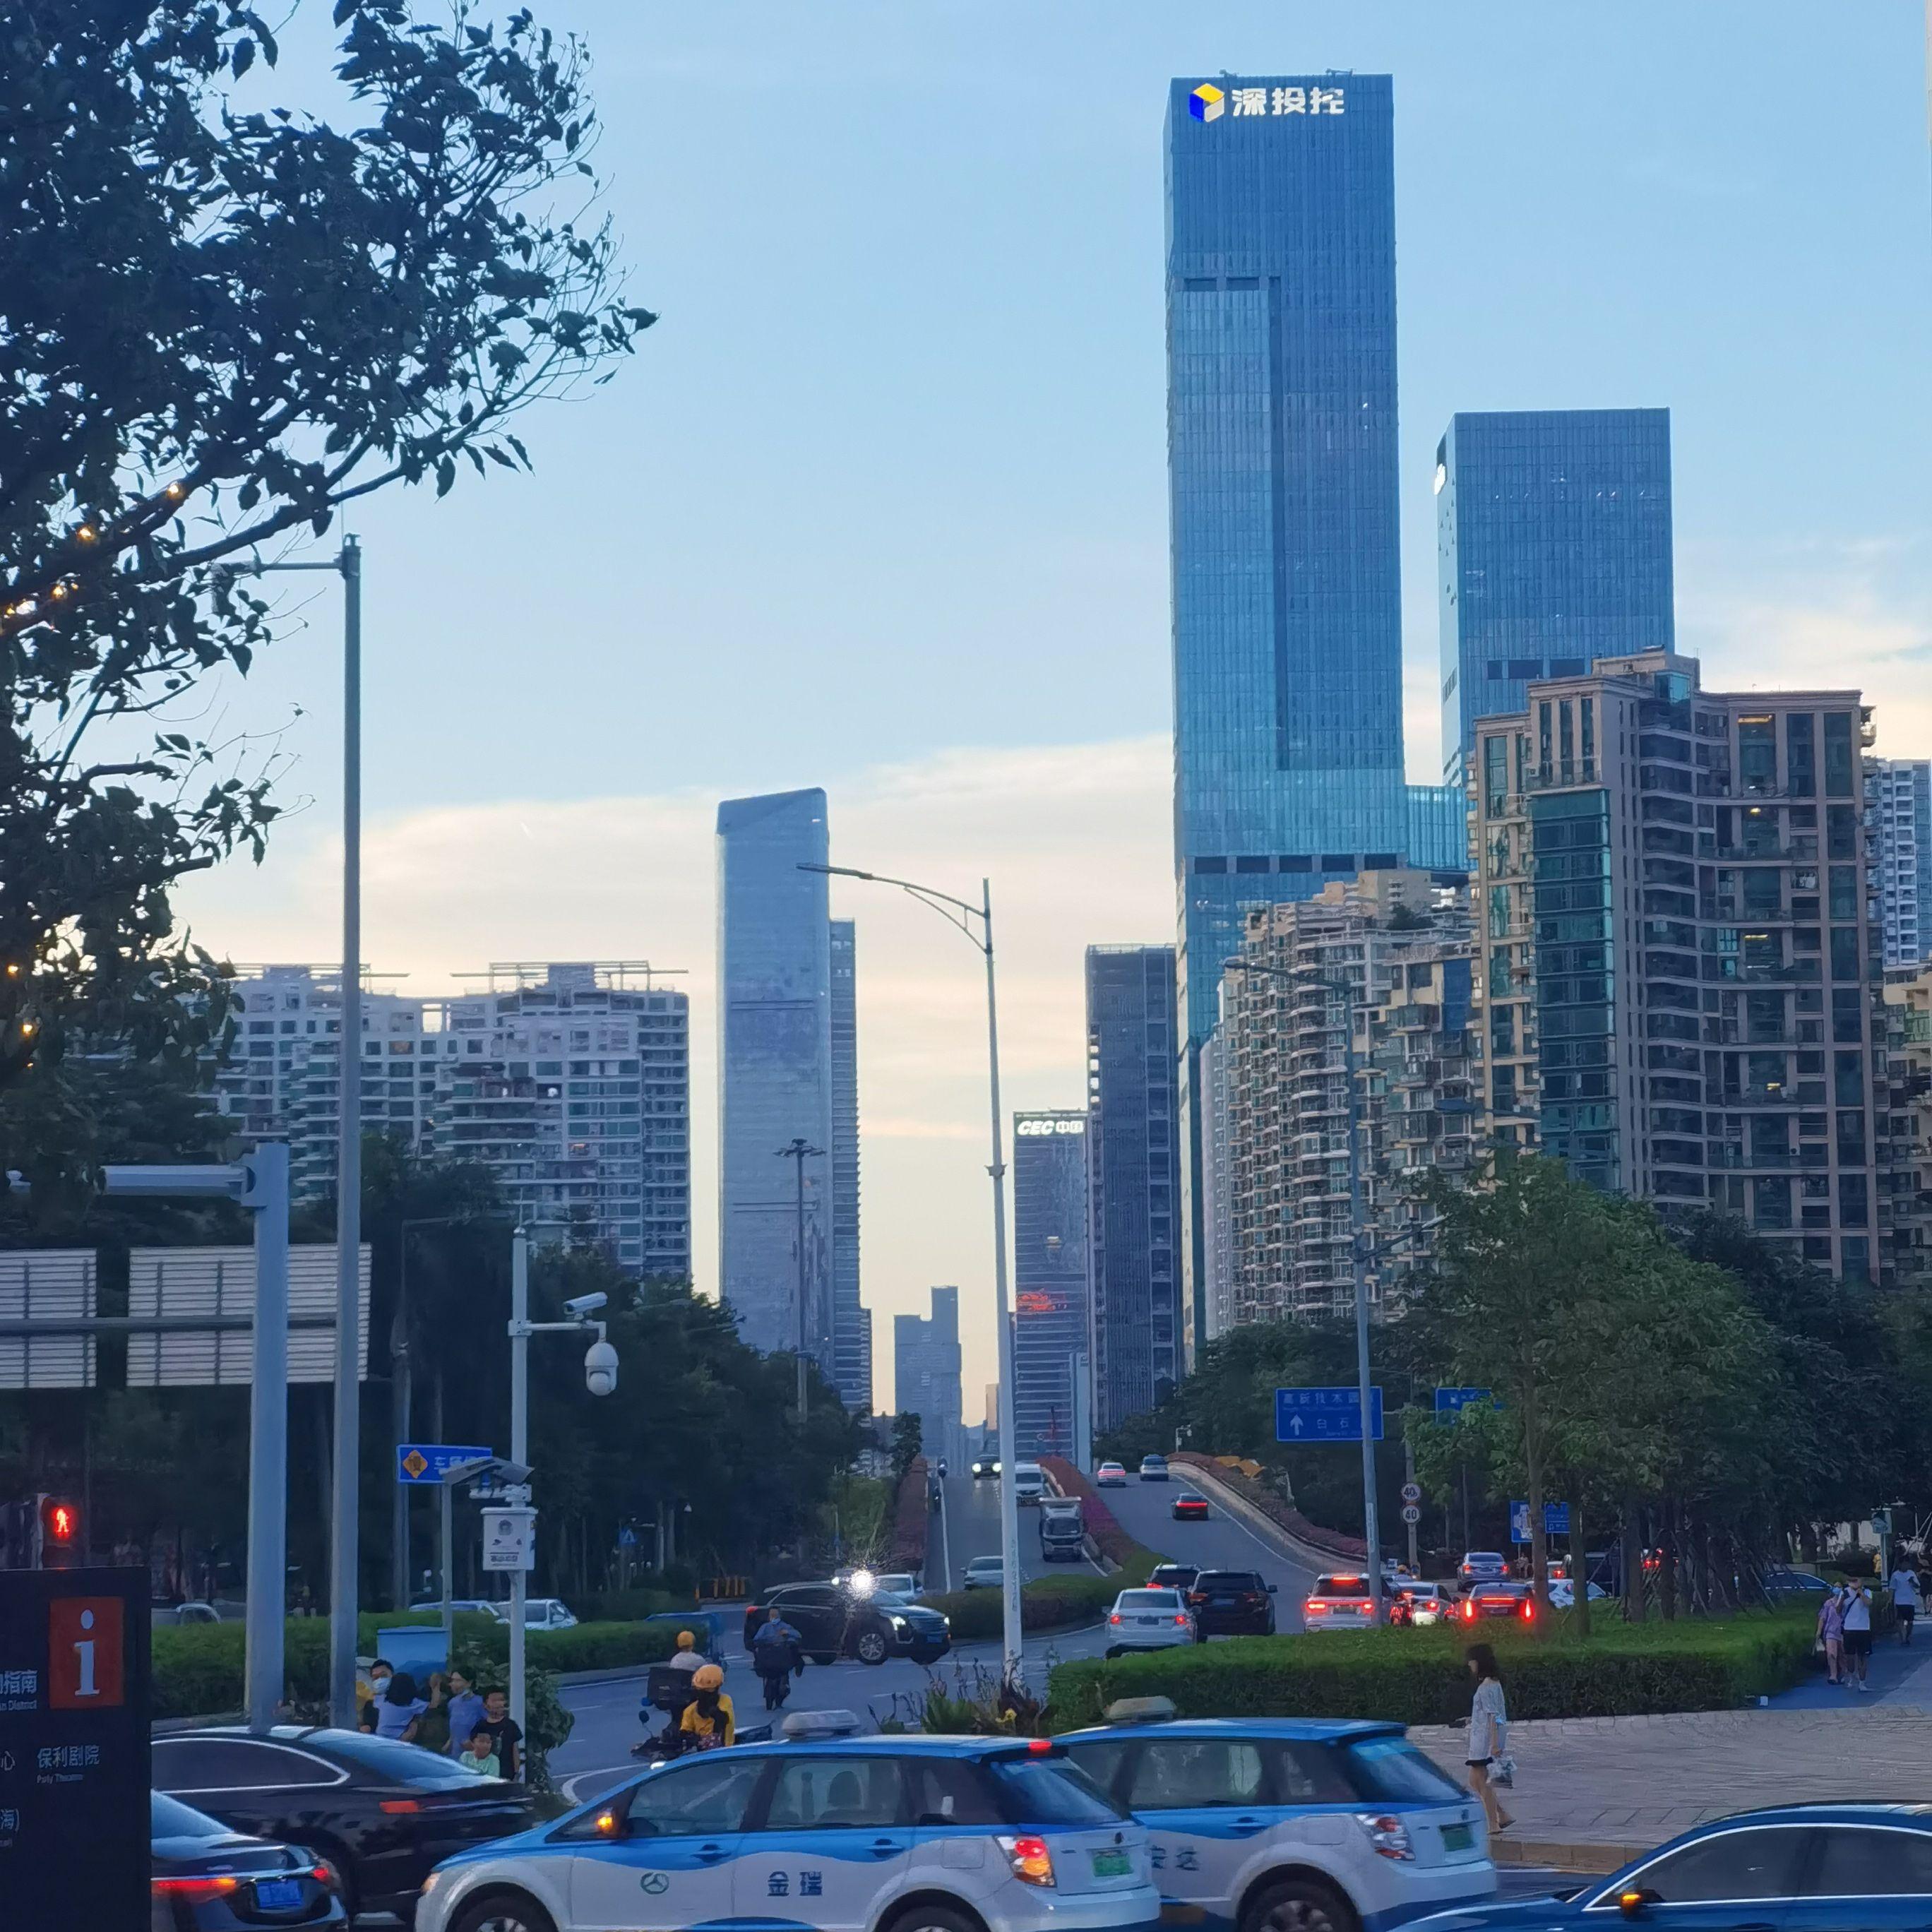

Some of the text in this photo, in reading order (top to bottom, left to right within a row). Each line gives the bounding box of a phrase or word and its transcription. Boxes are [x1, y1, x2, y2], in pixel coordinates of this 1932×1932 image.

[1018, 1121, 1055, 1135] CEC
[1405, 1509, 1417, 1520] 40
[0, 1670, 38, 1695] 指南
[37, 1744, 100, 1769] 保利剧院
[767, 1871, 823, 1897] 金瑞
